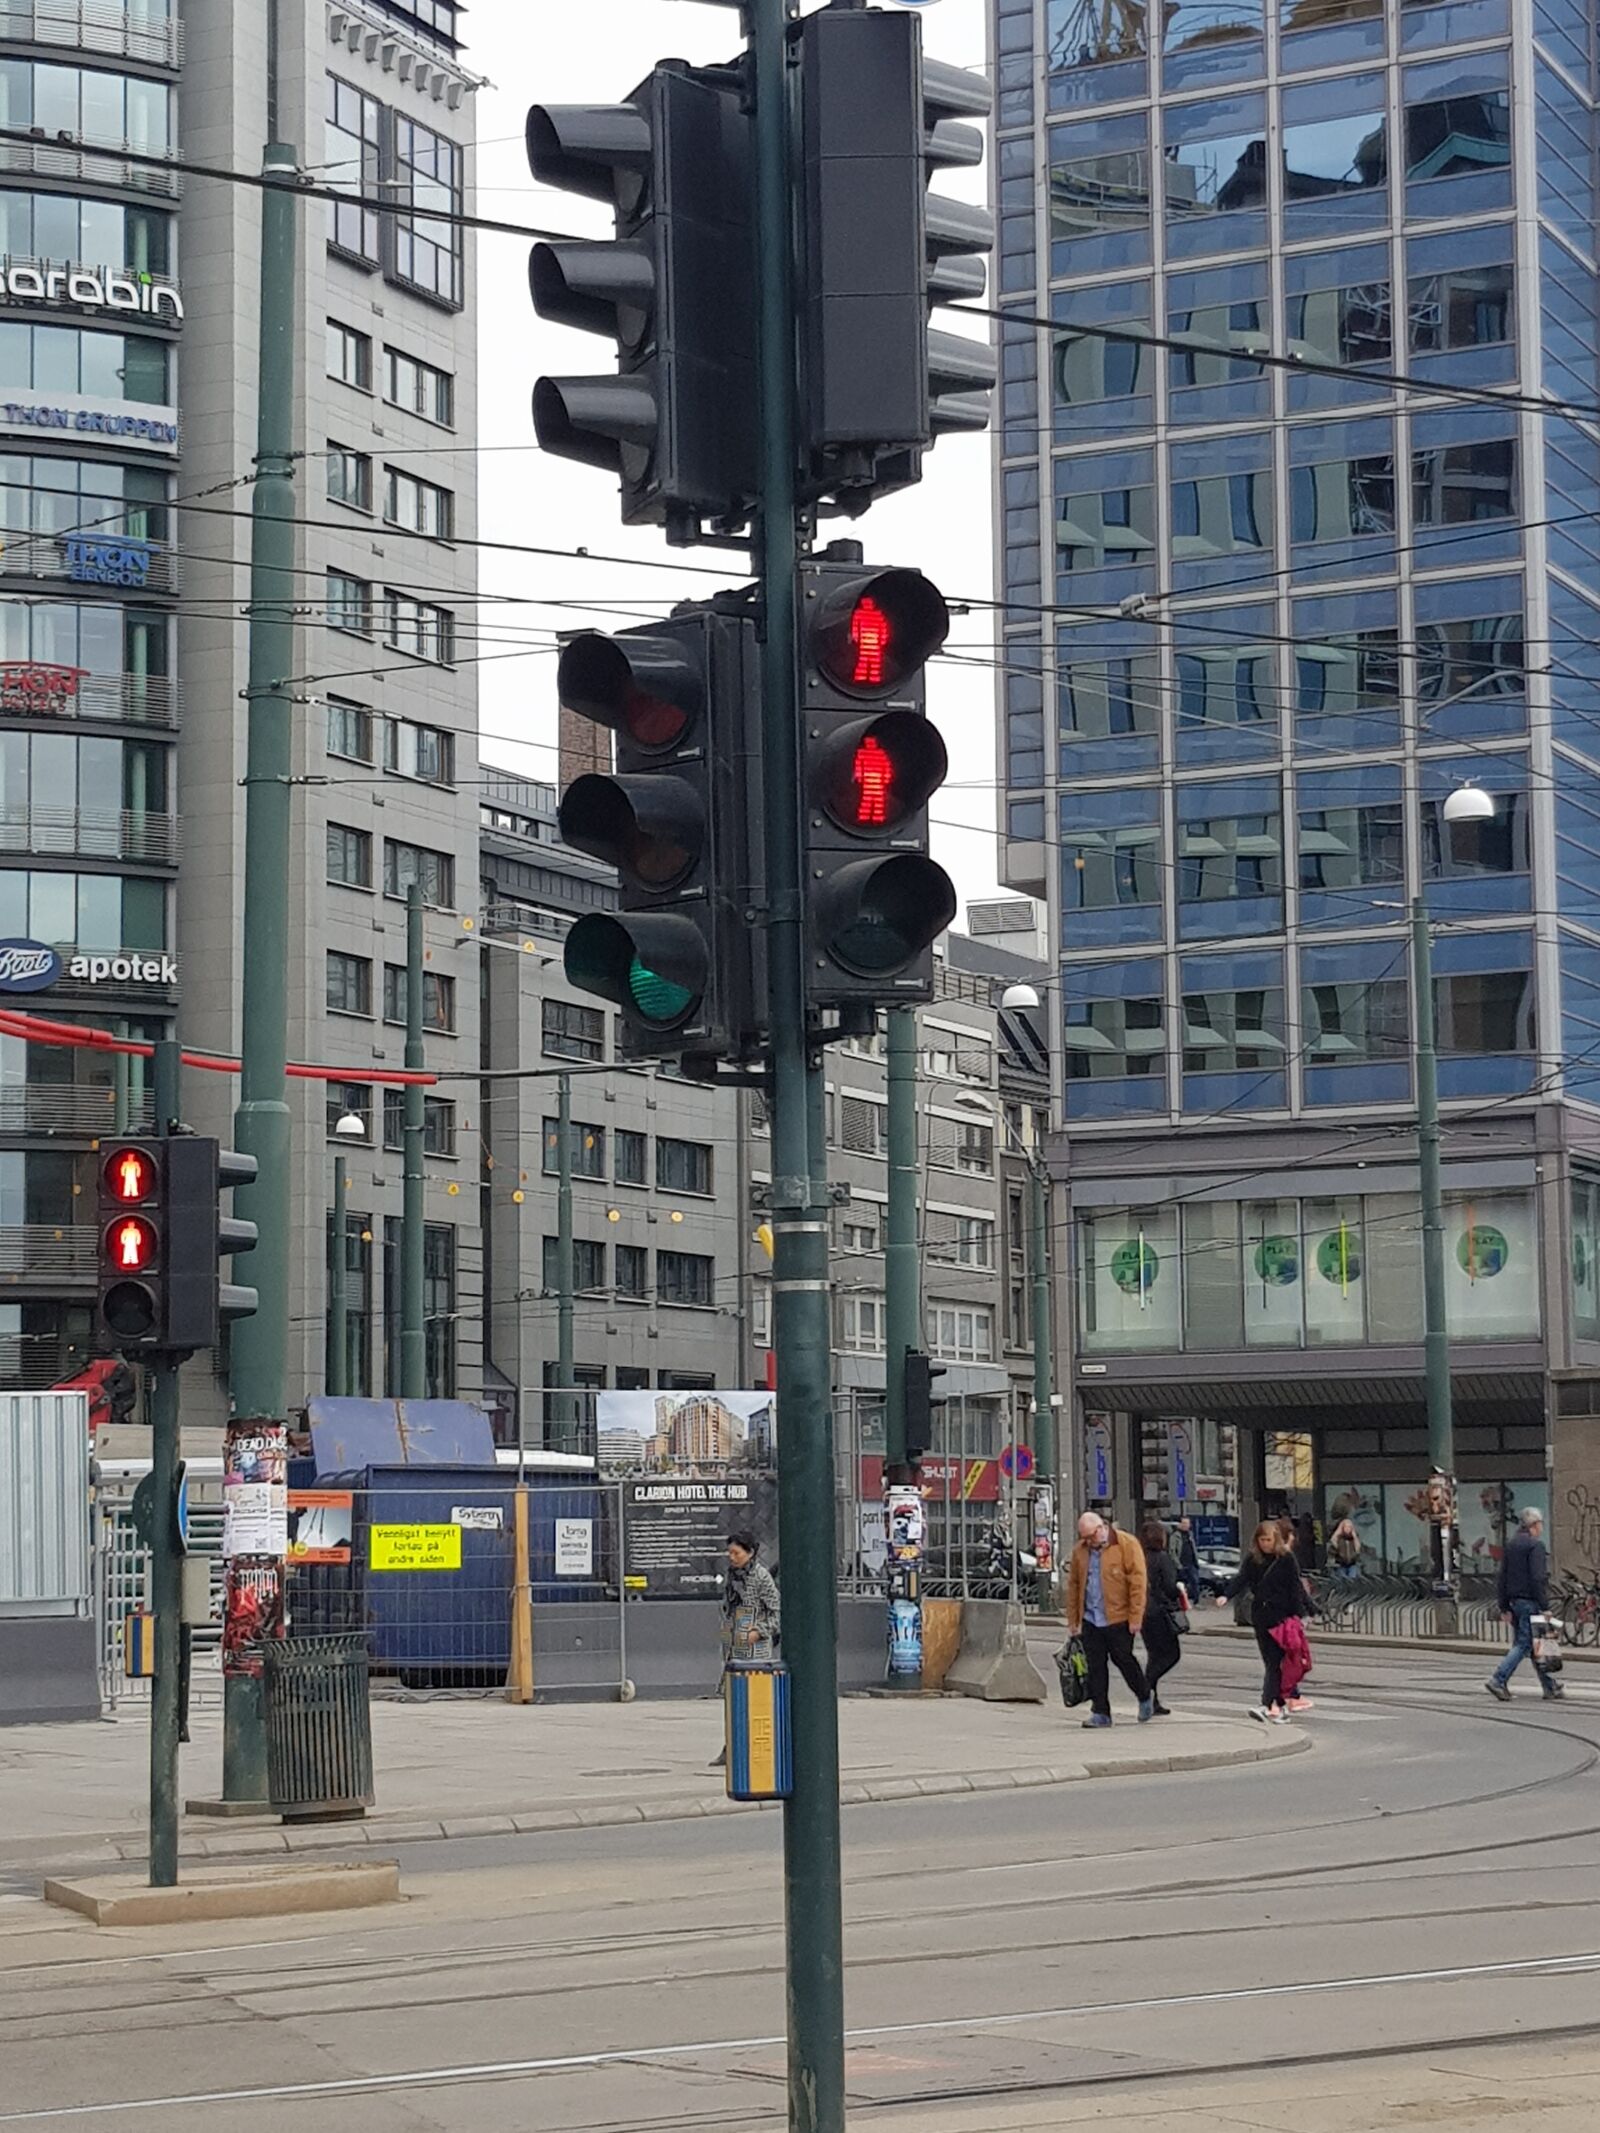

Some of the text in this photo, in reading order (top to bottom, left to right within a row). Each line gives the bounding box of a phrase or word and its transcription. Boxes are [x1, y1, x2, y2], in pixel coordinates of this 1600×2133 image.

[0, 265, 184, 319] arabin
[2, 669, 78, 696] HON
[70, 954, 178, 984] apotek
[237, 1437, 264, 1451] DEAD
[635, 1485, 748, 1500] CLARION HOTEL THE HUB
